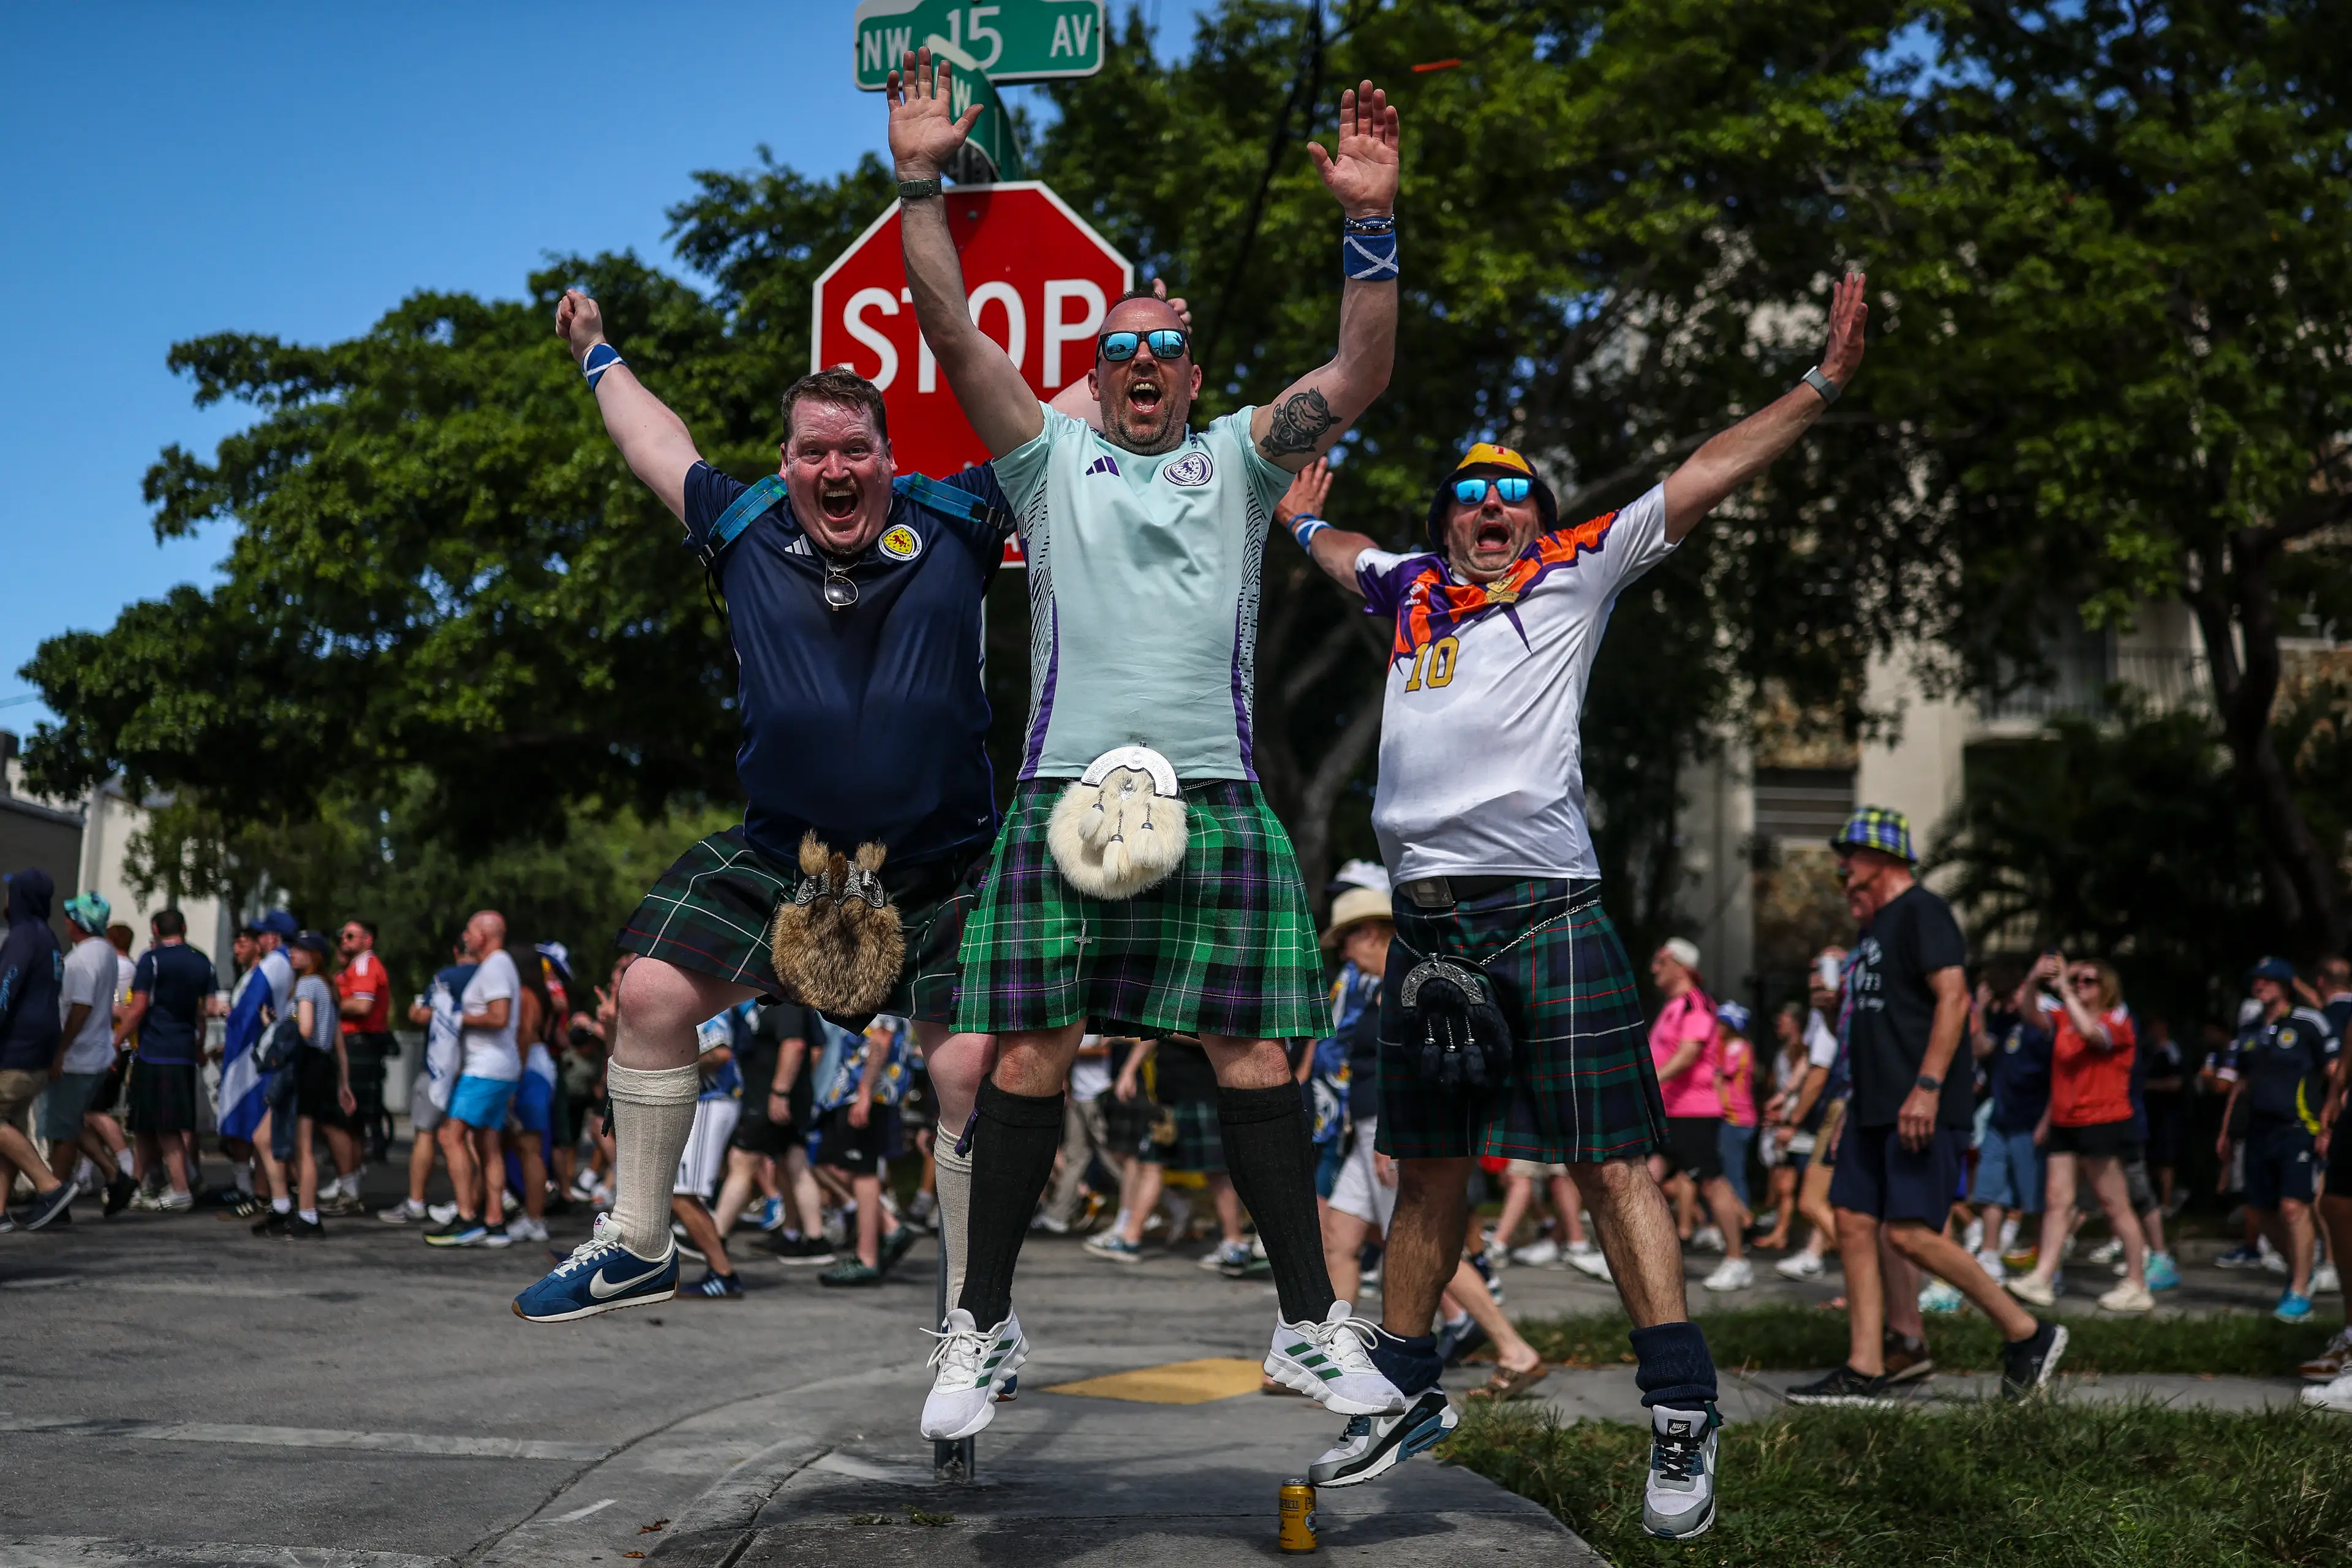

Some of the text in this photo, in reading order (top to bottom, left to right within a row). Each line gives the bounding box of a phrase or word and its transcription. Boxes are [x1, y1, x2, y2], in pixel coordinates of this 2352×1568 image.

[862, 6, 1093, 72] NW 15 AV
[1404, 635, 1460, 693] 10
